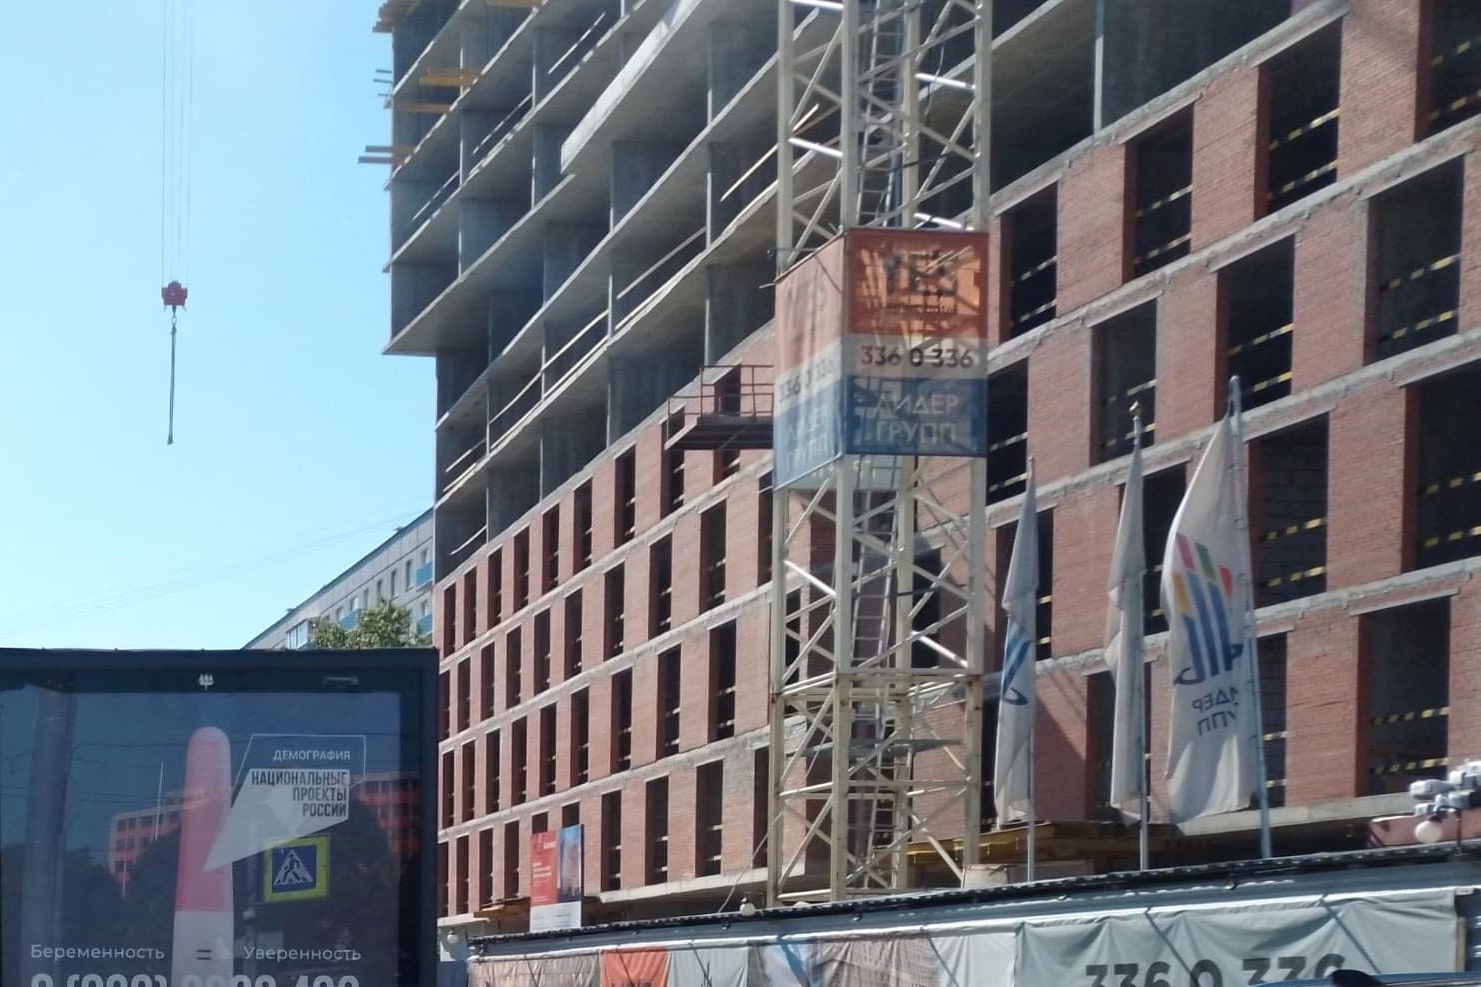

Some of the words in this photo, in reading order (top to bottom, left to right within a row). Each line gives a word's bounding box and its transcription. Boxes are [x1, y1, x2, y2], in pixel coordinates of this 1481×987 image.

[860, 345, 901, 366] 336
[930, 348, 973, 369] 336
[876, 420, 956, 444] ГРУПП
[273, 750, 351, 762] ДЕМОГРАФИЯ
[251, 770, 348, 786] НАЦИОНАЛЬНЫЕ
[293, 787, 347, 801] ПРОЕКТЫ
[302, 803, 347, 817] РОССИИ
[30, 944, 165, 960] Беременность
[243, 945, 362, 962] Уверенность
